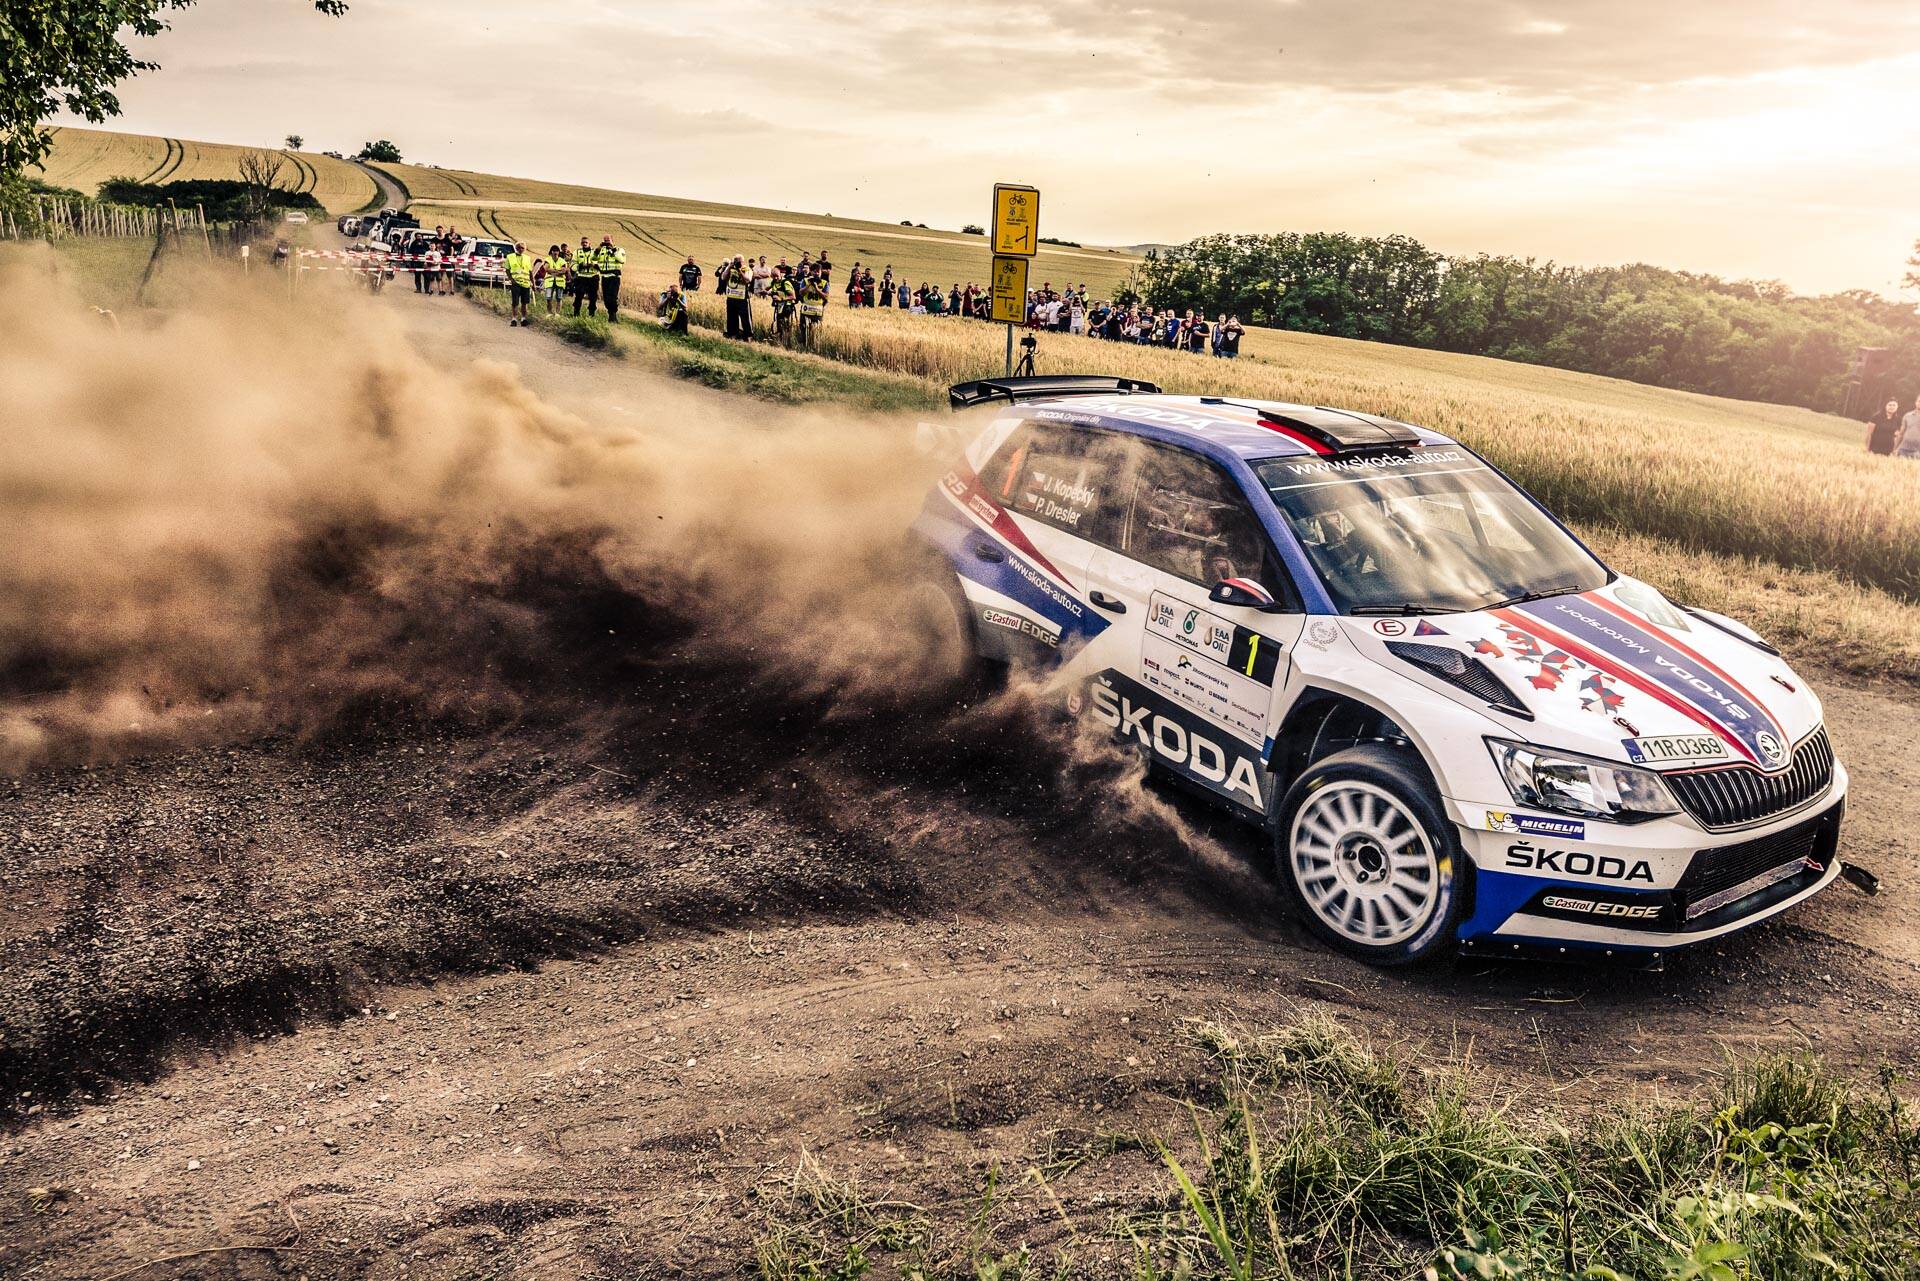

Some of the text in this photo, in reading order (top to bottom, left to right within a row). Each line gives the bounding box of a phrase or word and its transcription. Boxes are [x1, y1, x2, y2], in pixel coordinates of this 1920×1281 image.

[1287, 452, 1465, 475] www.skoda-auto.cz
[1043, 476, 1095, 508] J. Kopecký
[1035, 498, 1082, 526] P. Dresler
[1008, 555, 1083, 618] www.skoda-auto.cz
[1160, 604, 1174, 616] EAA
[992, 613, 1059, 648] Castrol EDGE
[1158, 616, 1169, 628] OIL
[1381, 622, 1399, 632] E
[1175, 633, 1199, 648] PETRONAS
[1215, 628, 1230, 641] EAA
[1212, 640, 1224, 653] OIL
[1248, 634, 1260, 677] 1
[1555, 604, 1751, 721] ŠKODA Motorsport
[1091, 675, 1264, 810] ŠKODA
[1677, 738, 1722, 755] 0369
[1520, 820, 1585, 834] MICHELIN
[1505, 840, 1655, 883] ŠKODA
[1555, 898, 1663, 918] Castrol EDGE
